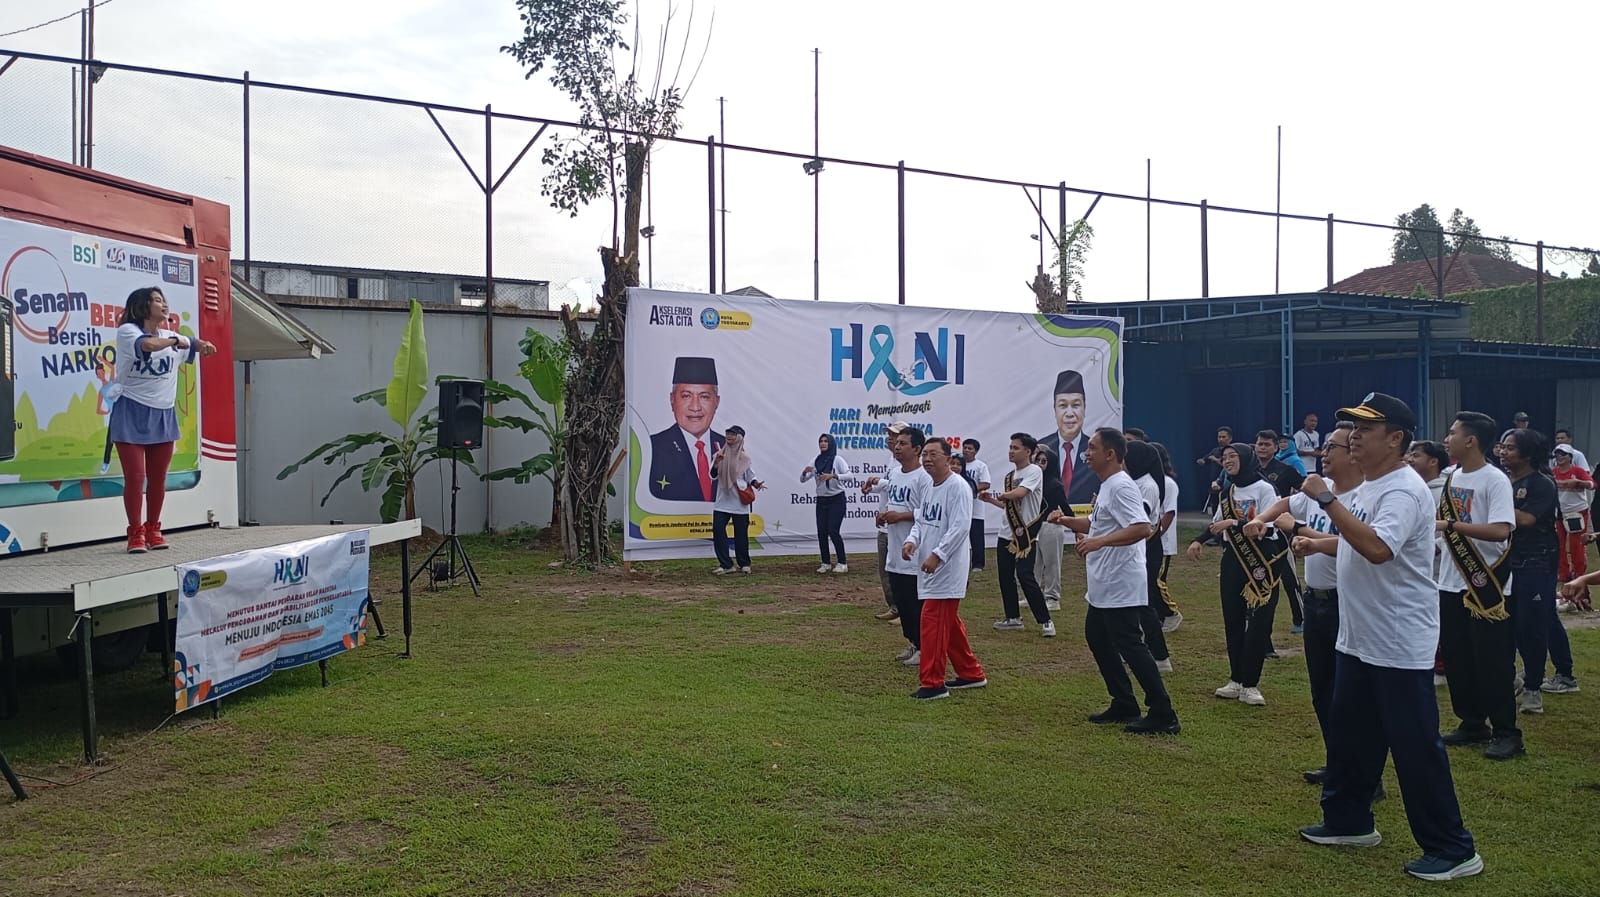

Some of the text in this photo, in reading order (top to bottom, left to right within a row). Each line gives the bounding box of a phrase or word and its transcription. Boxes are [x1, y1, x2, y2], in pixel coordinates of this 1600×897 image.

[73, 245, 96, 265] BSI
[14, 288, 89, 315] Senam
[676, 315, 693, 327] CITA
[48, 326, 102, 346] Bersih
[41, 345, 117, 379] NARKO
[829, 408, 861, 421] HARI
[867, 400, 931, 420] Memperingati
[829, 422, 860, 436] ANTI
[863, 462, 888, 474] Rant
[860, 493, 880, 504] dan
[256, 599, 278, 612] RANTAI
[225, 626, 260, 646] MENUJU
[304, 609, 320, 623] EMAS
[320, 604, 334, 617] 2045
